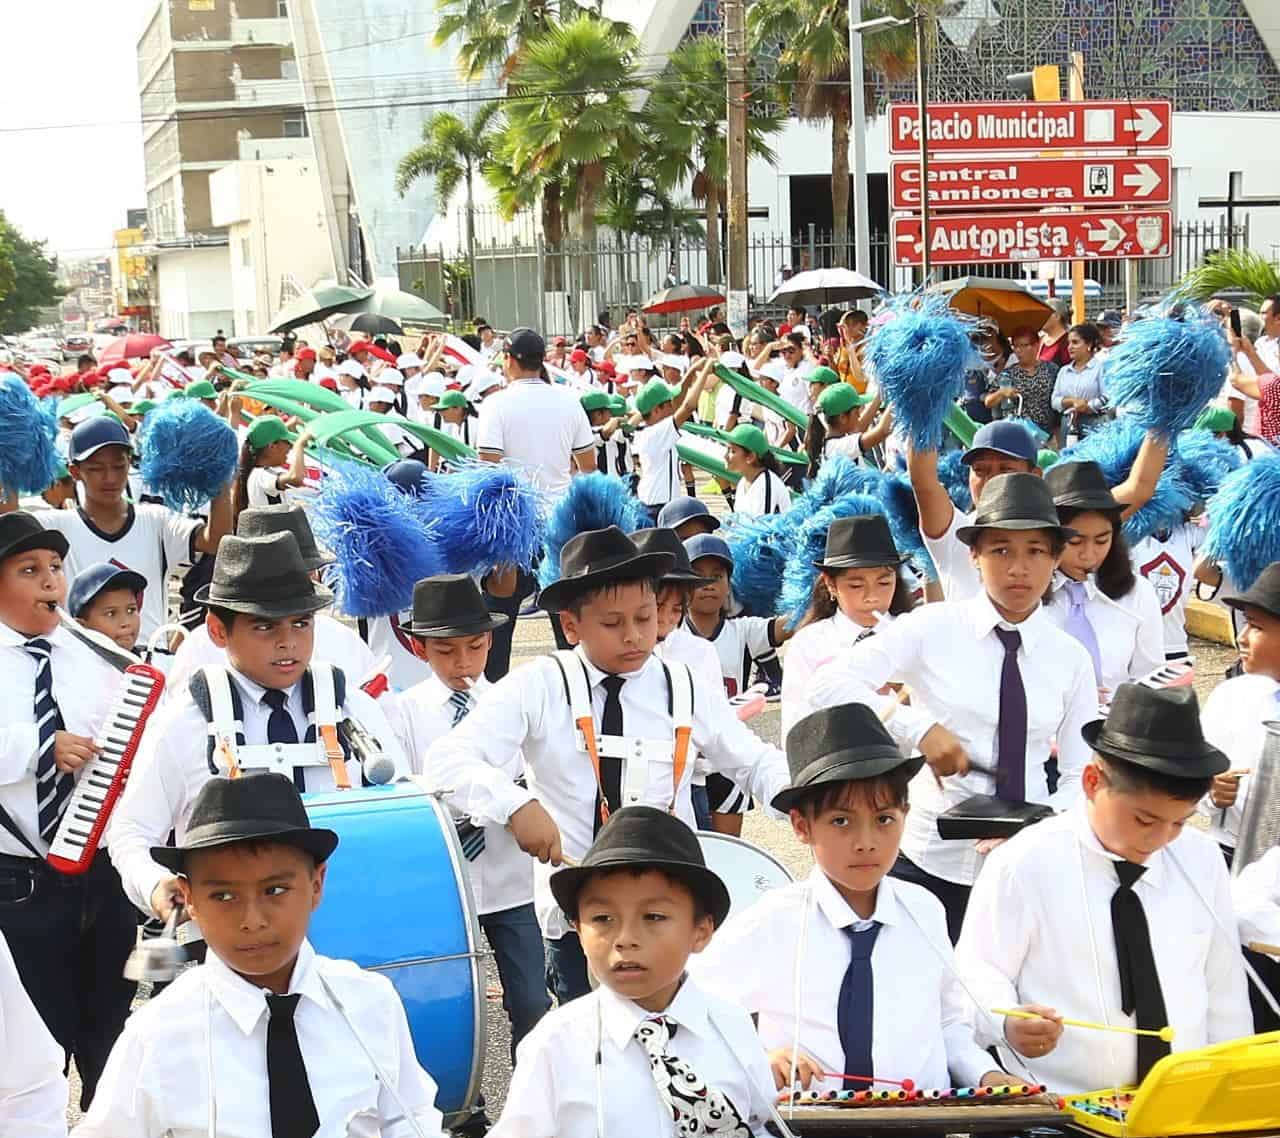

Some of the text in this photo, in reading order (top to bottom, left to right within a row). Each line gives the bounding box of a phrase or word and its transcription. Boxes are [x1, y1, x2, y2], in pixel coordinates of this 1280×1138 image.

[898, 110, 1075, 144] Palacio Municipal
[900, 166, 1017, 182] Central
[901, 185, 1074, 201] Camionera
[930, 220, 1068, 254] Autopista
